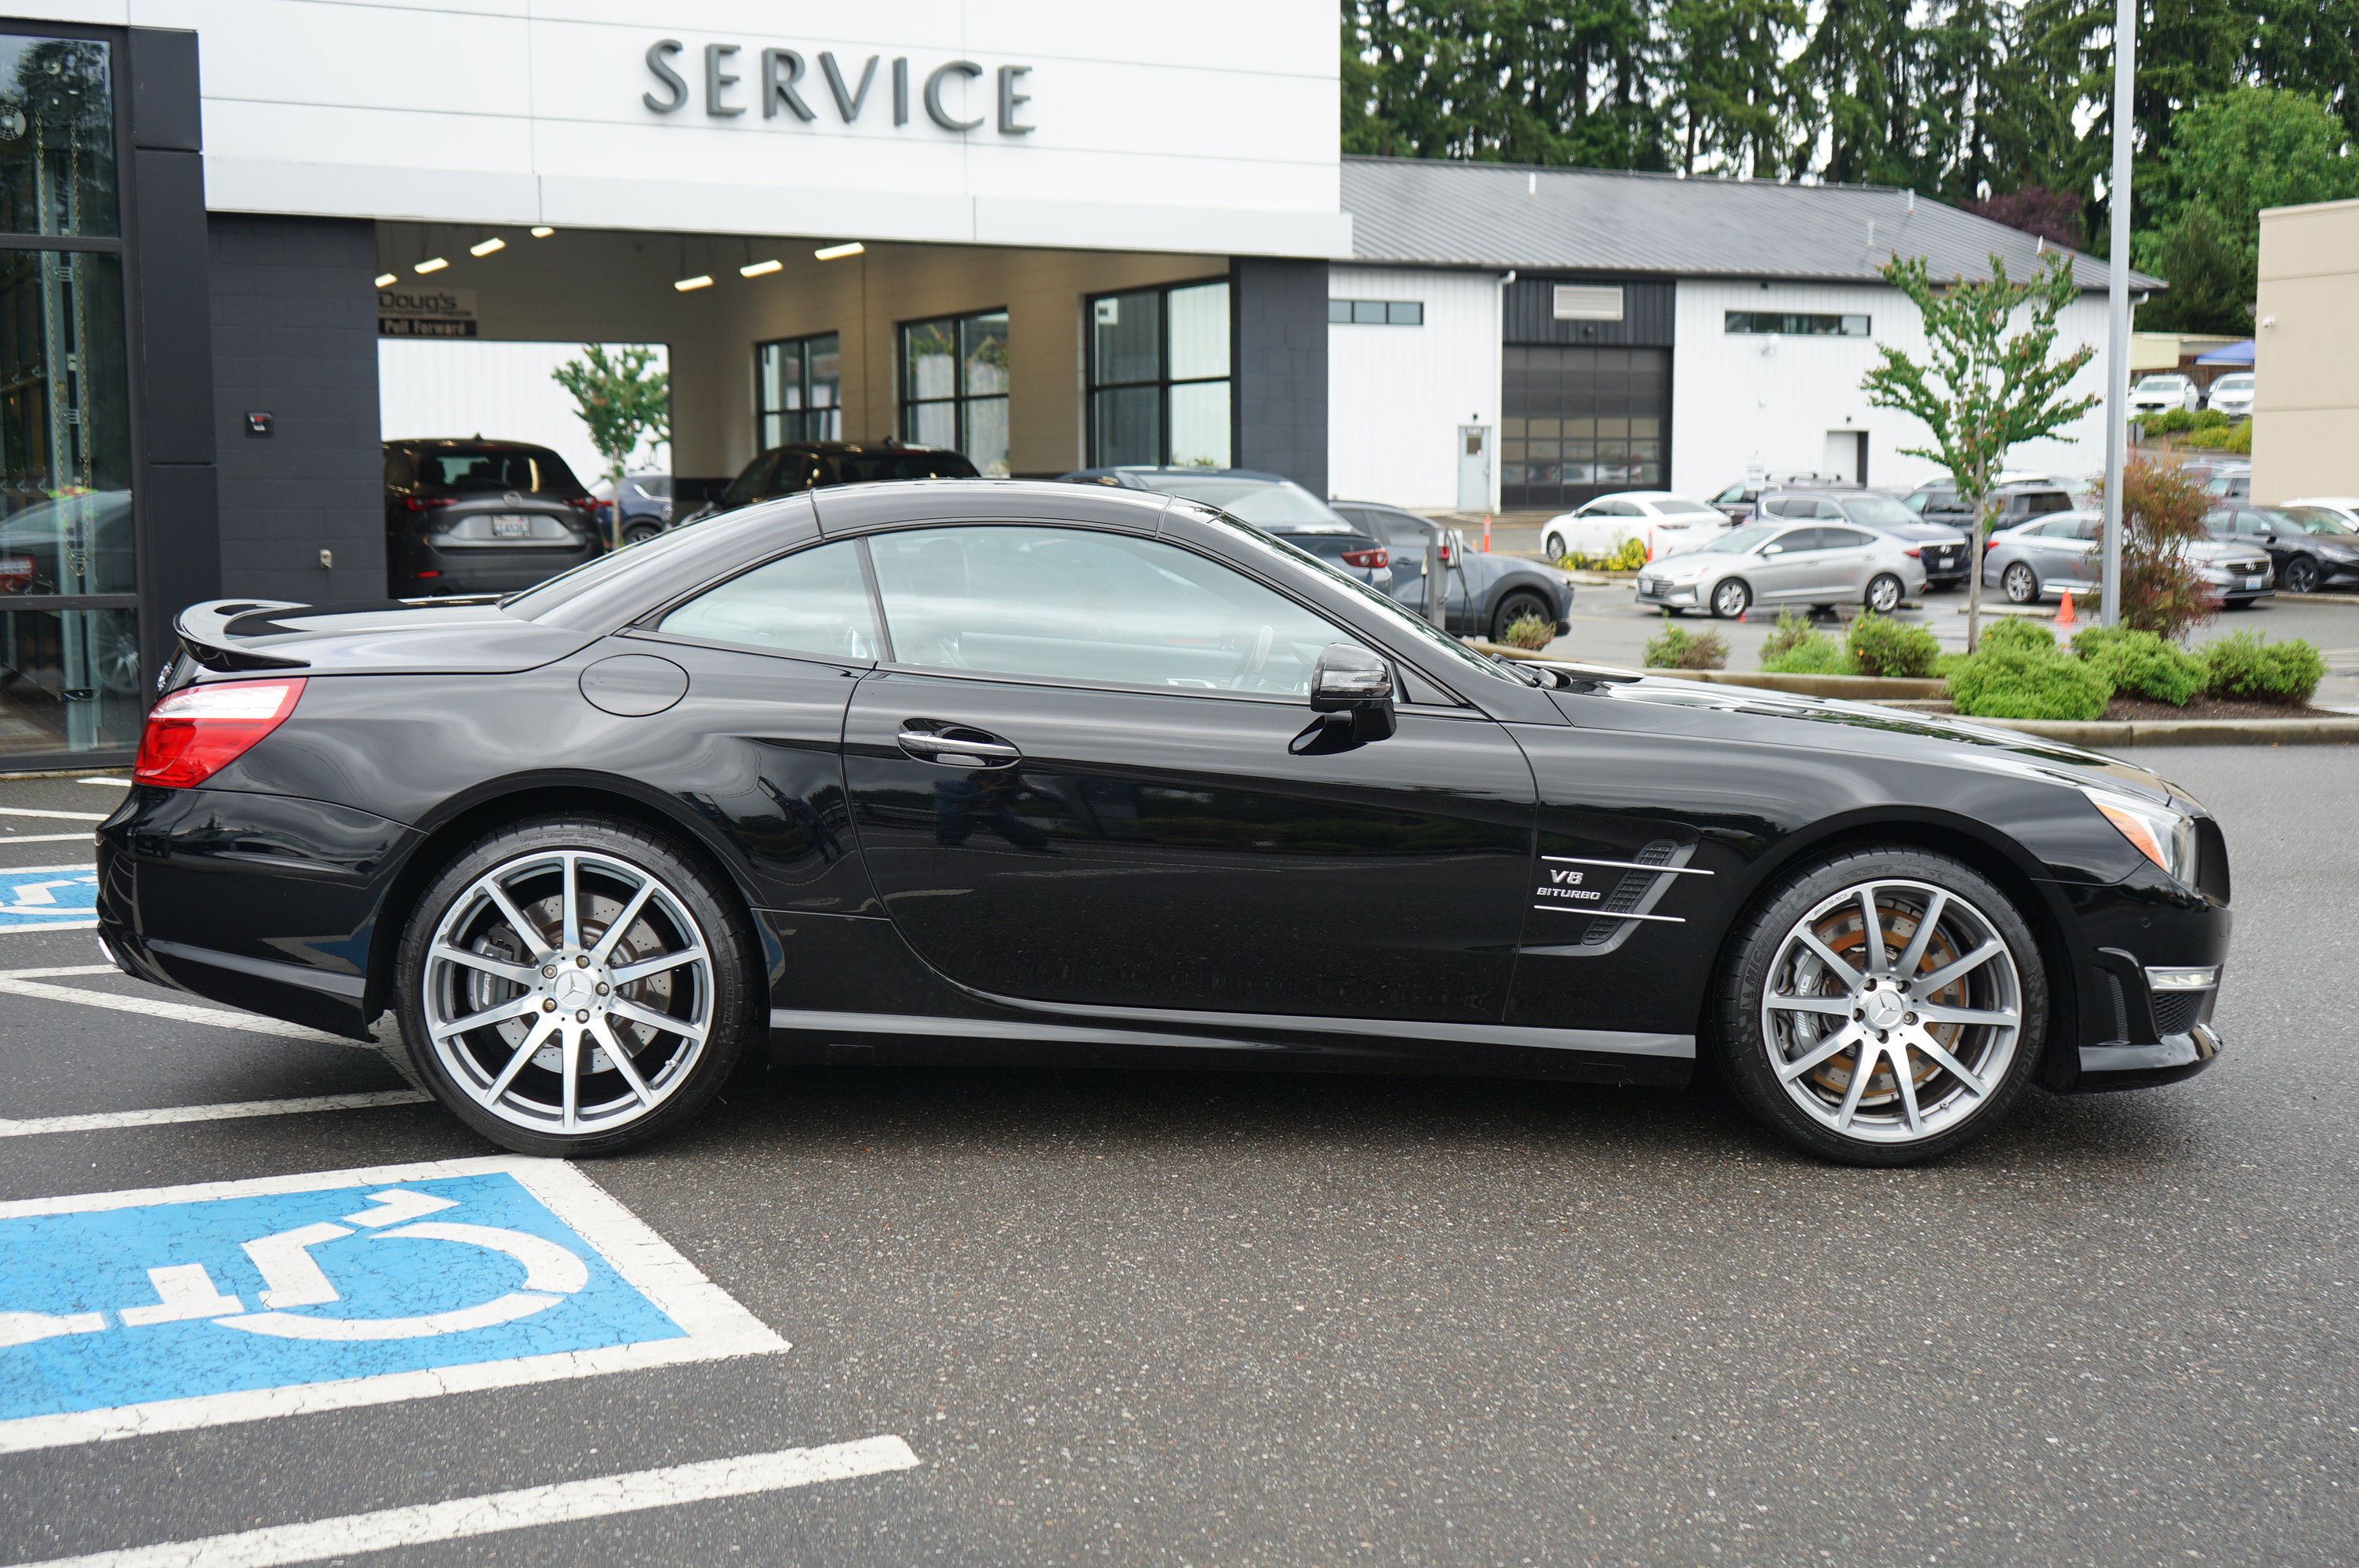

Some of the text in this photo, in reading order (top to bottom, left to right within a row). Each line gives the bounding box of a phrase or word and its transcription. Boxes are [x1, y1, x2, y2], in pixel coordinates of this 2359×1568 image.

[643, 39, 1036, 135] SERVICE
[378, 291, 456, 313] Doug's
[385, 319, 465, 336] Pull Forward
[1550, 869, 1584, 885] V8
[1537, 887, 1601, 900] BITURBO
[1744, 901, 1796, 986] MICHELIN
[724, 967, 734, 1024] MICHELIN
